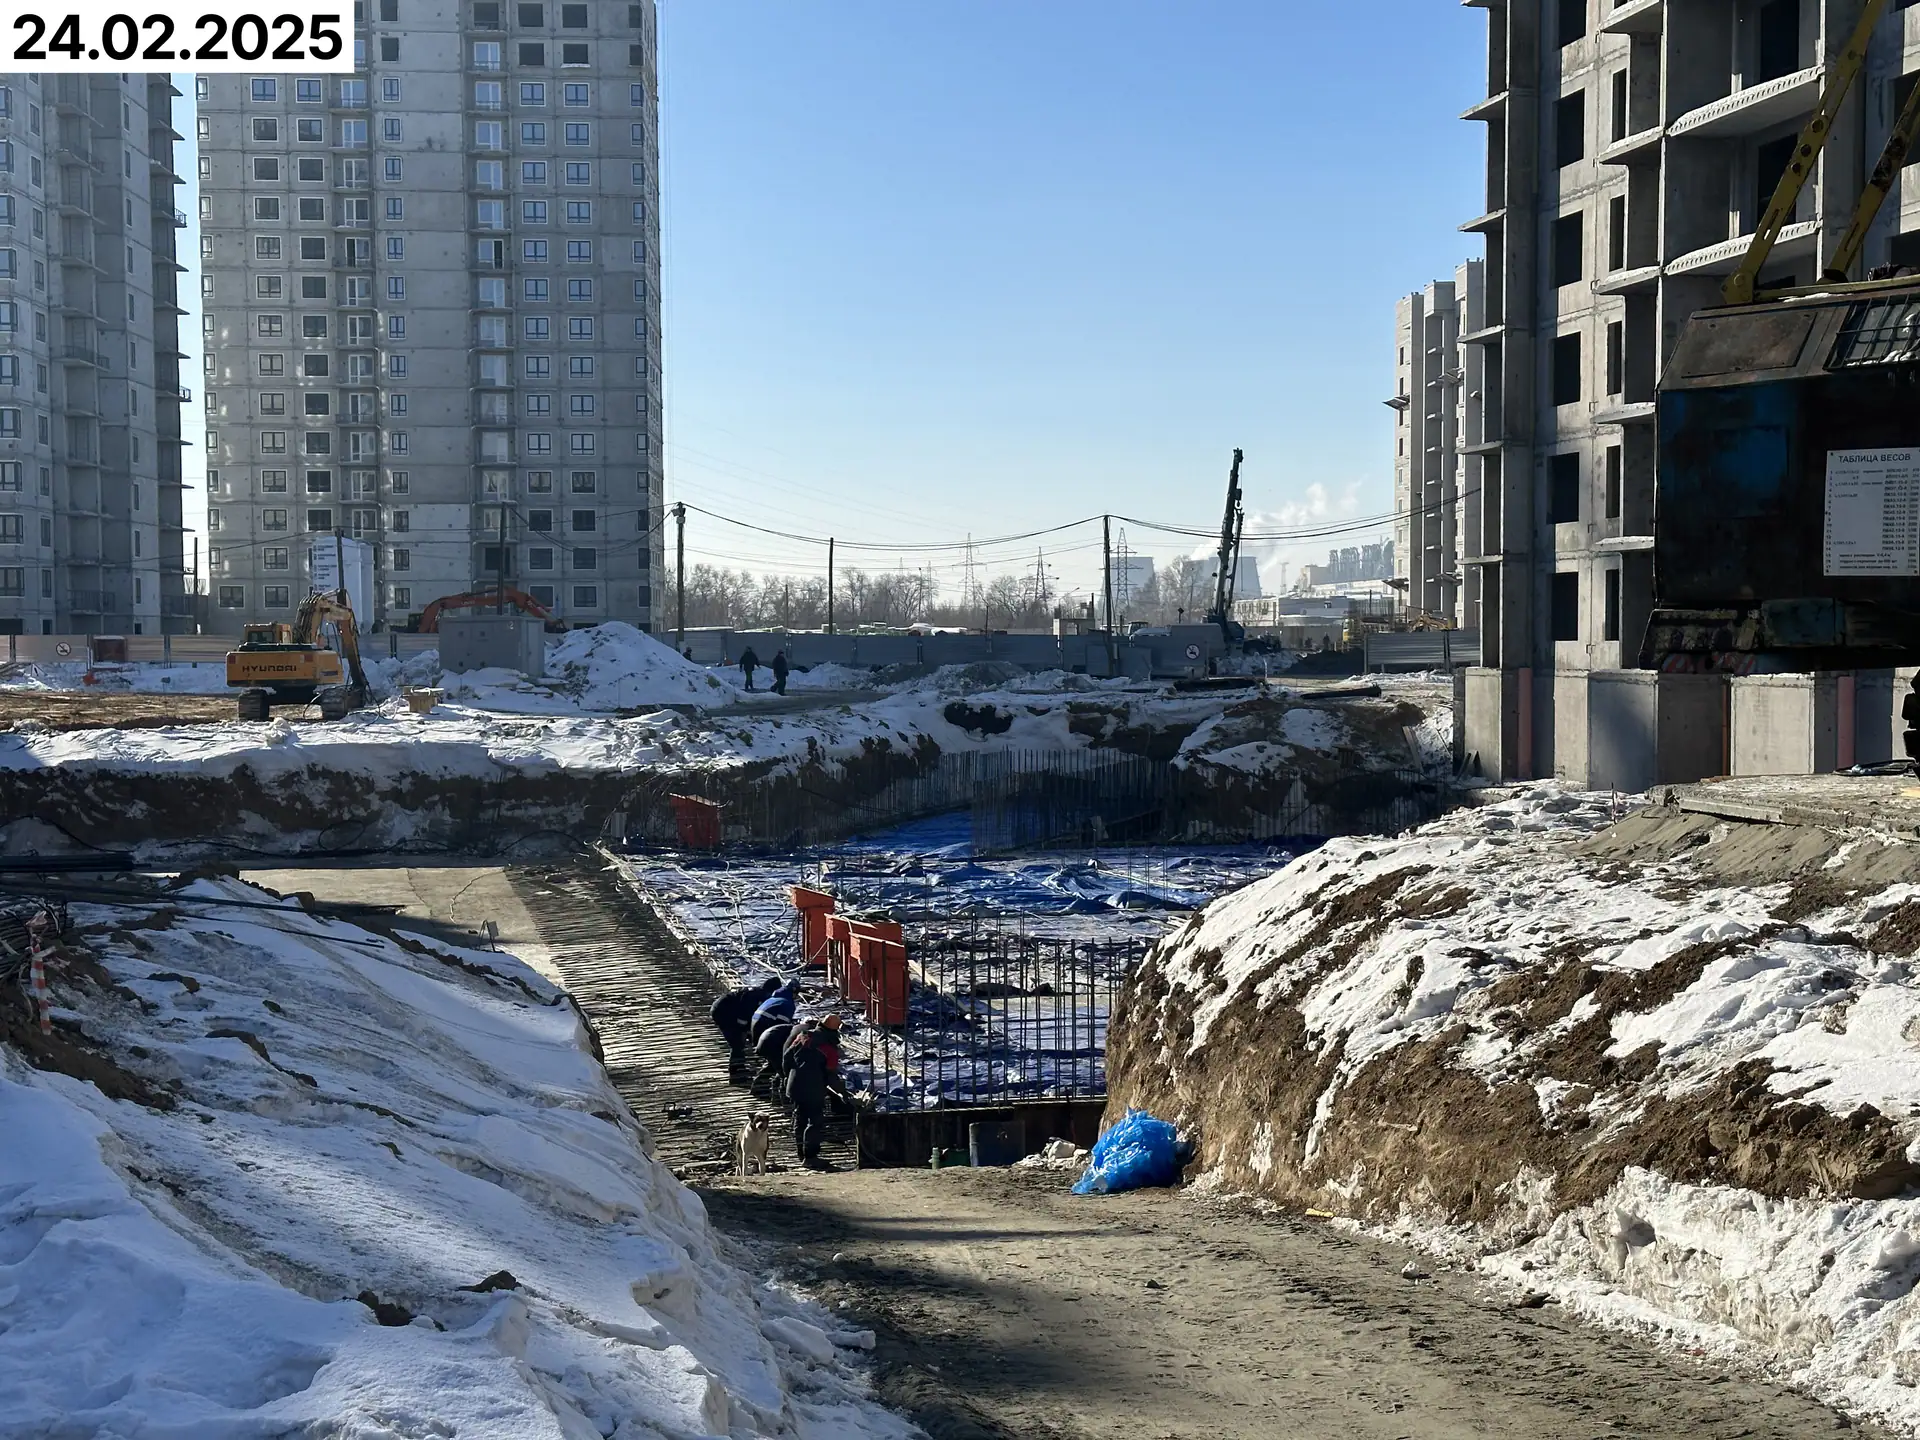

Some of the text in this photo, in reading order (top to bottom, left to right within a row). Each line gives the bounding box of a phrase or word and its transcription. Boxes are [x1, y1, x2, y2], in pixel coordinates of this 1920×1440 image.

[1838, 453, 1911, 463] ТАБЛИЦА ВЕСОВ
[242, 665, 297, 673] HYUNDAI
